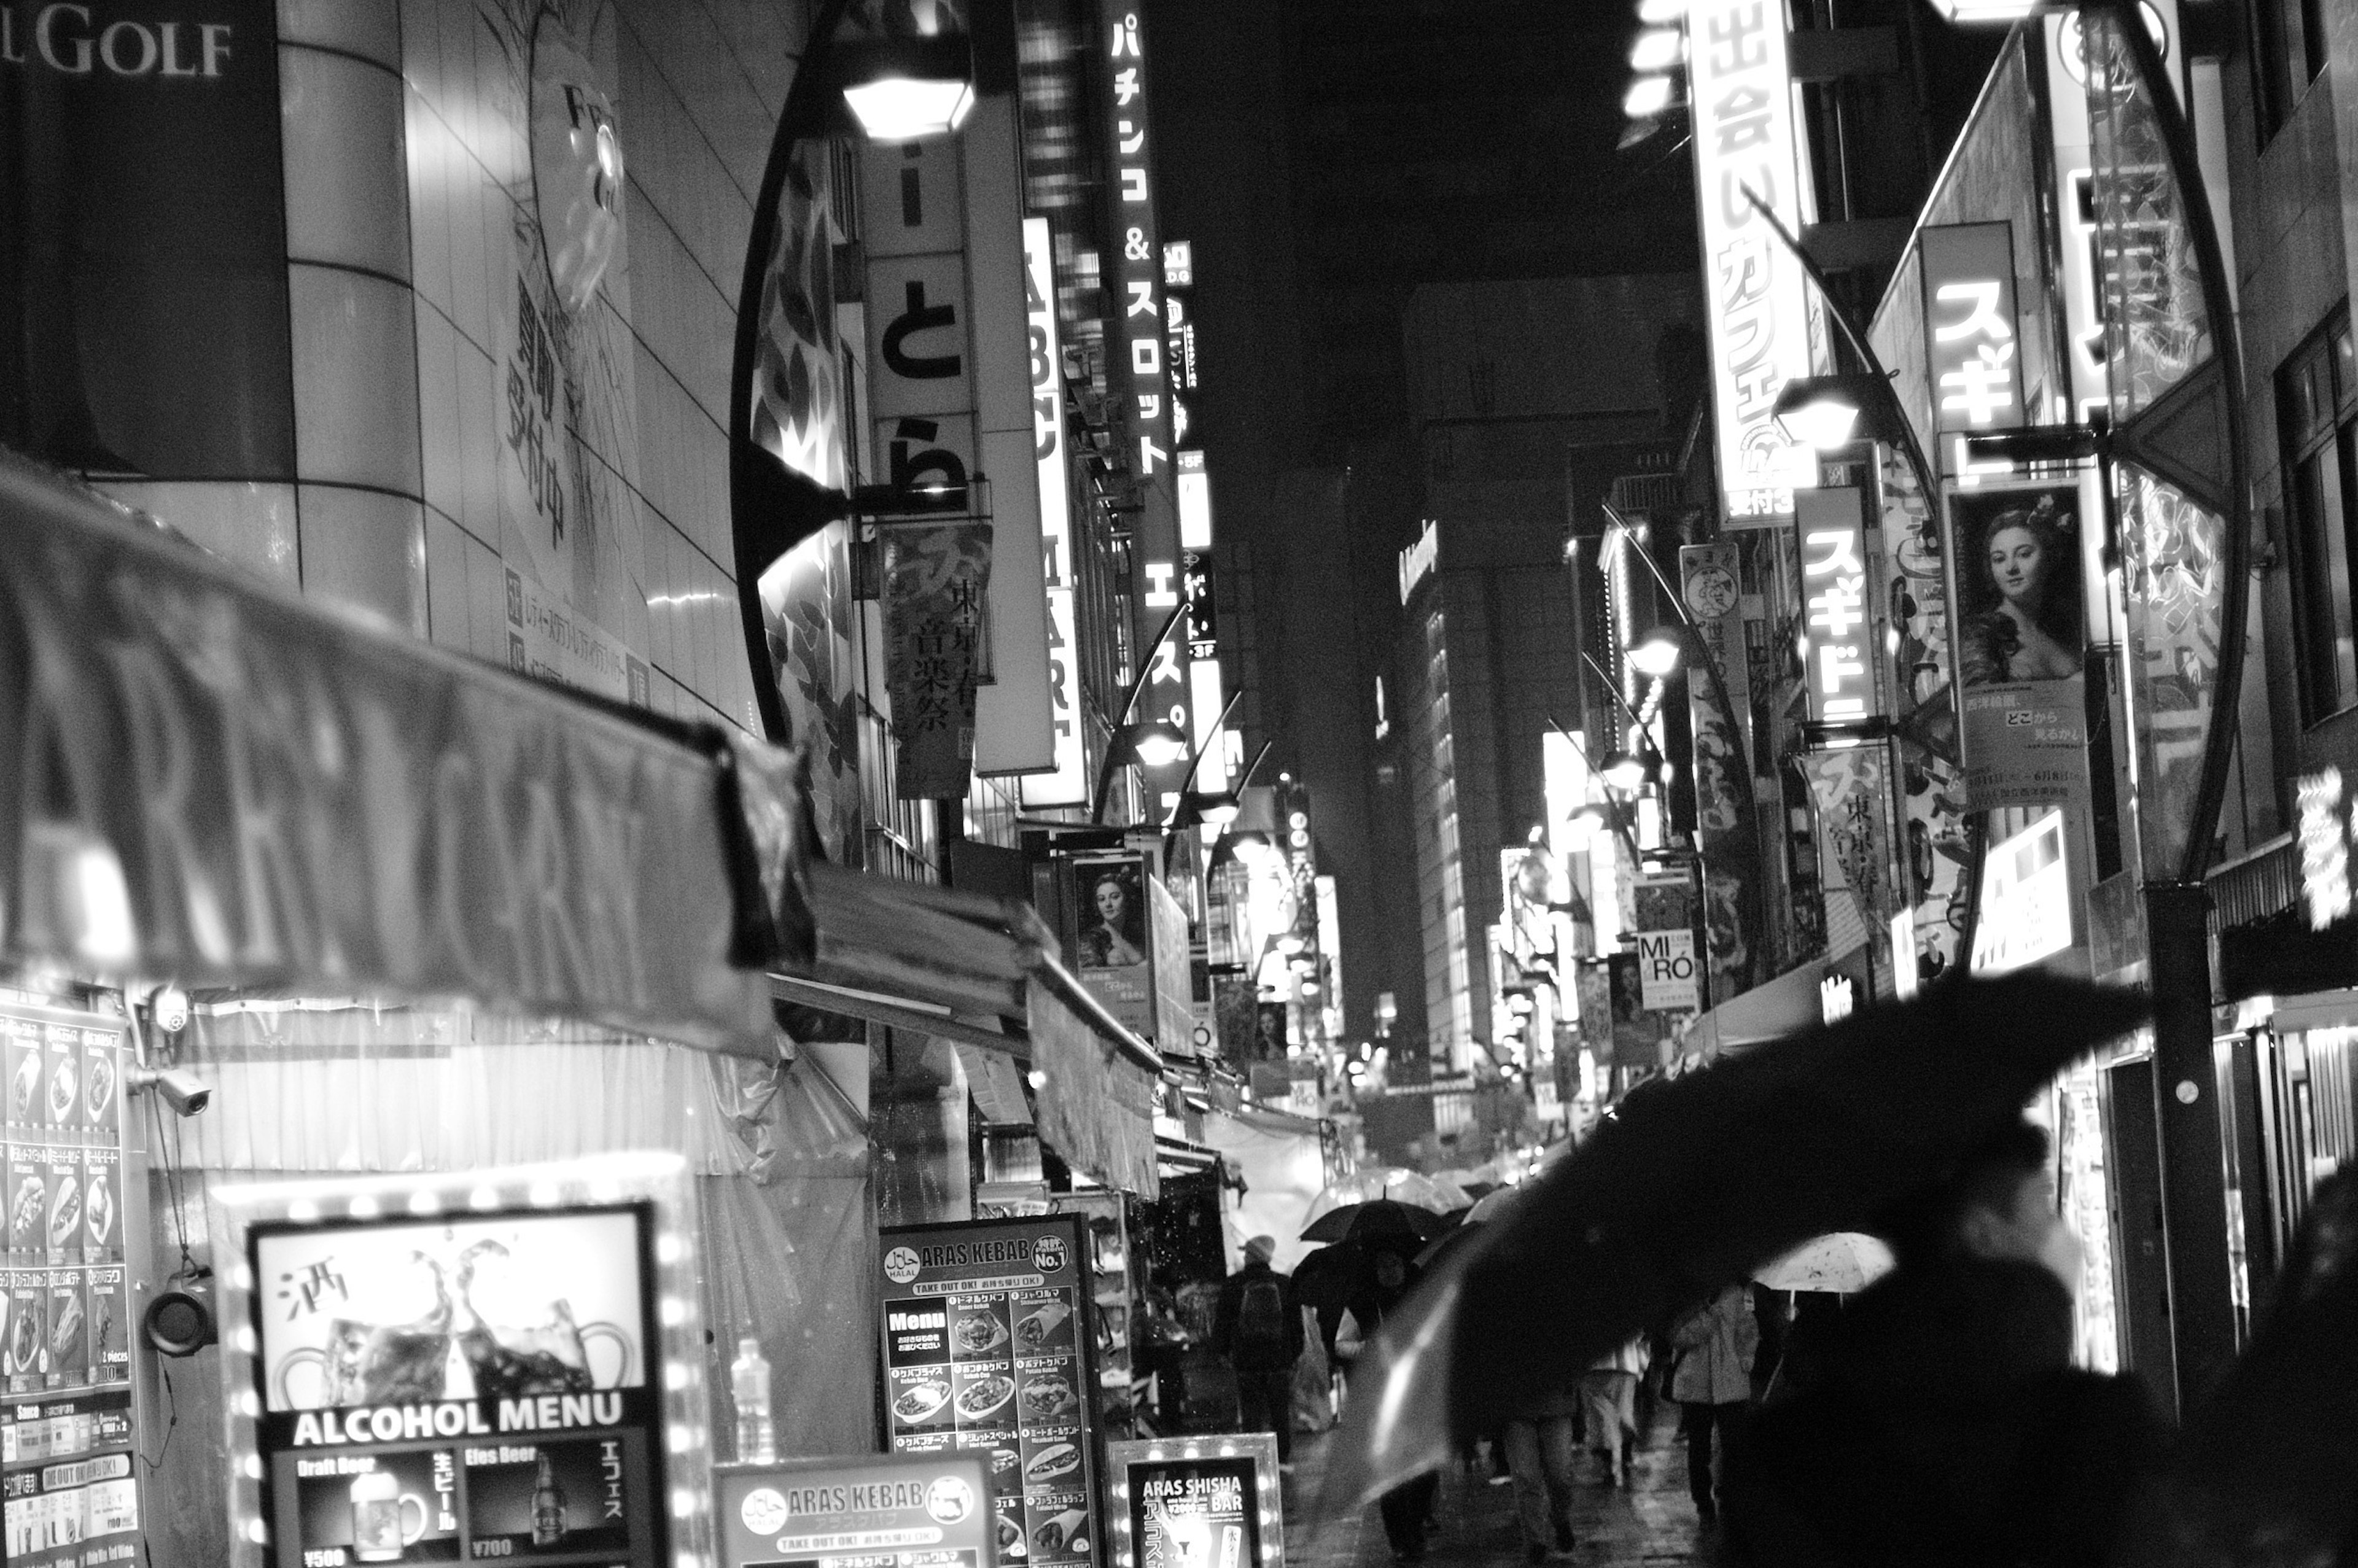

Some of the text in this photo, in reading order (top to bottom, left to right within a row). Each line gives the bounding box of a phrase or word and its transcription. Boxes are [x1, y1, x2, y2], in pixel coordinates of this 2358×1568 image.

[35, 2, 233, 76] GOLF
[1640, 935, 1670, 960] MI
[921, 1238, 1030, 1268] ARAS KEBAB
[1035, 1252, 1066, 1268] No.1
[889, 1269, 917, 1278] HALAL
[276, 1254, 350, 1322] 酒
[916, 1283, 940, 1294] TAKE
[940, 1281, 959, 1292] OUT
[960, 1281, 978, 1291] OK!
[1022, 1277, 1040, 1287] OK!
[888, 1311, 946, 1332] Menu
[292, 1391, 623, 1446] ALCOHOL MENU
[464, 1445, 537, 1466] Efes Beer
[297, 1456, 376, 1477] Draft Beer
[432, 1453, 457, 1531] 生ビール
[1143, 1475, 1242, 1497] ARAS SHISHA
[787, 1481, 925, 1516] ARAS KEBAB
[1211, 1494, 1243, 1512] BAR
[472, 1539, 512, 1558] ¥700
[781, 1539, 811, 1550] TAKE
[812, 1537, 835, 1548] OUT
[838, 1535, 858, 1547] OK!
[303, 1548, 346, 1568] ¥500
